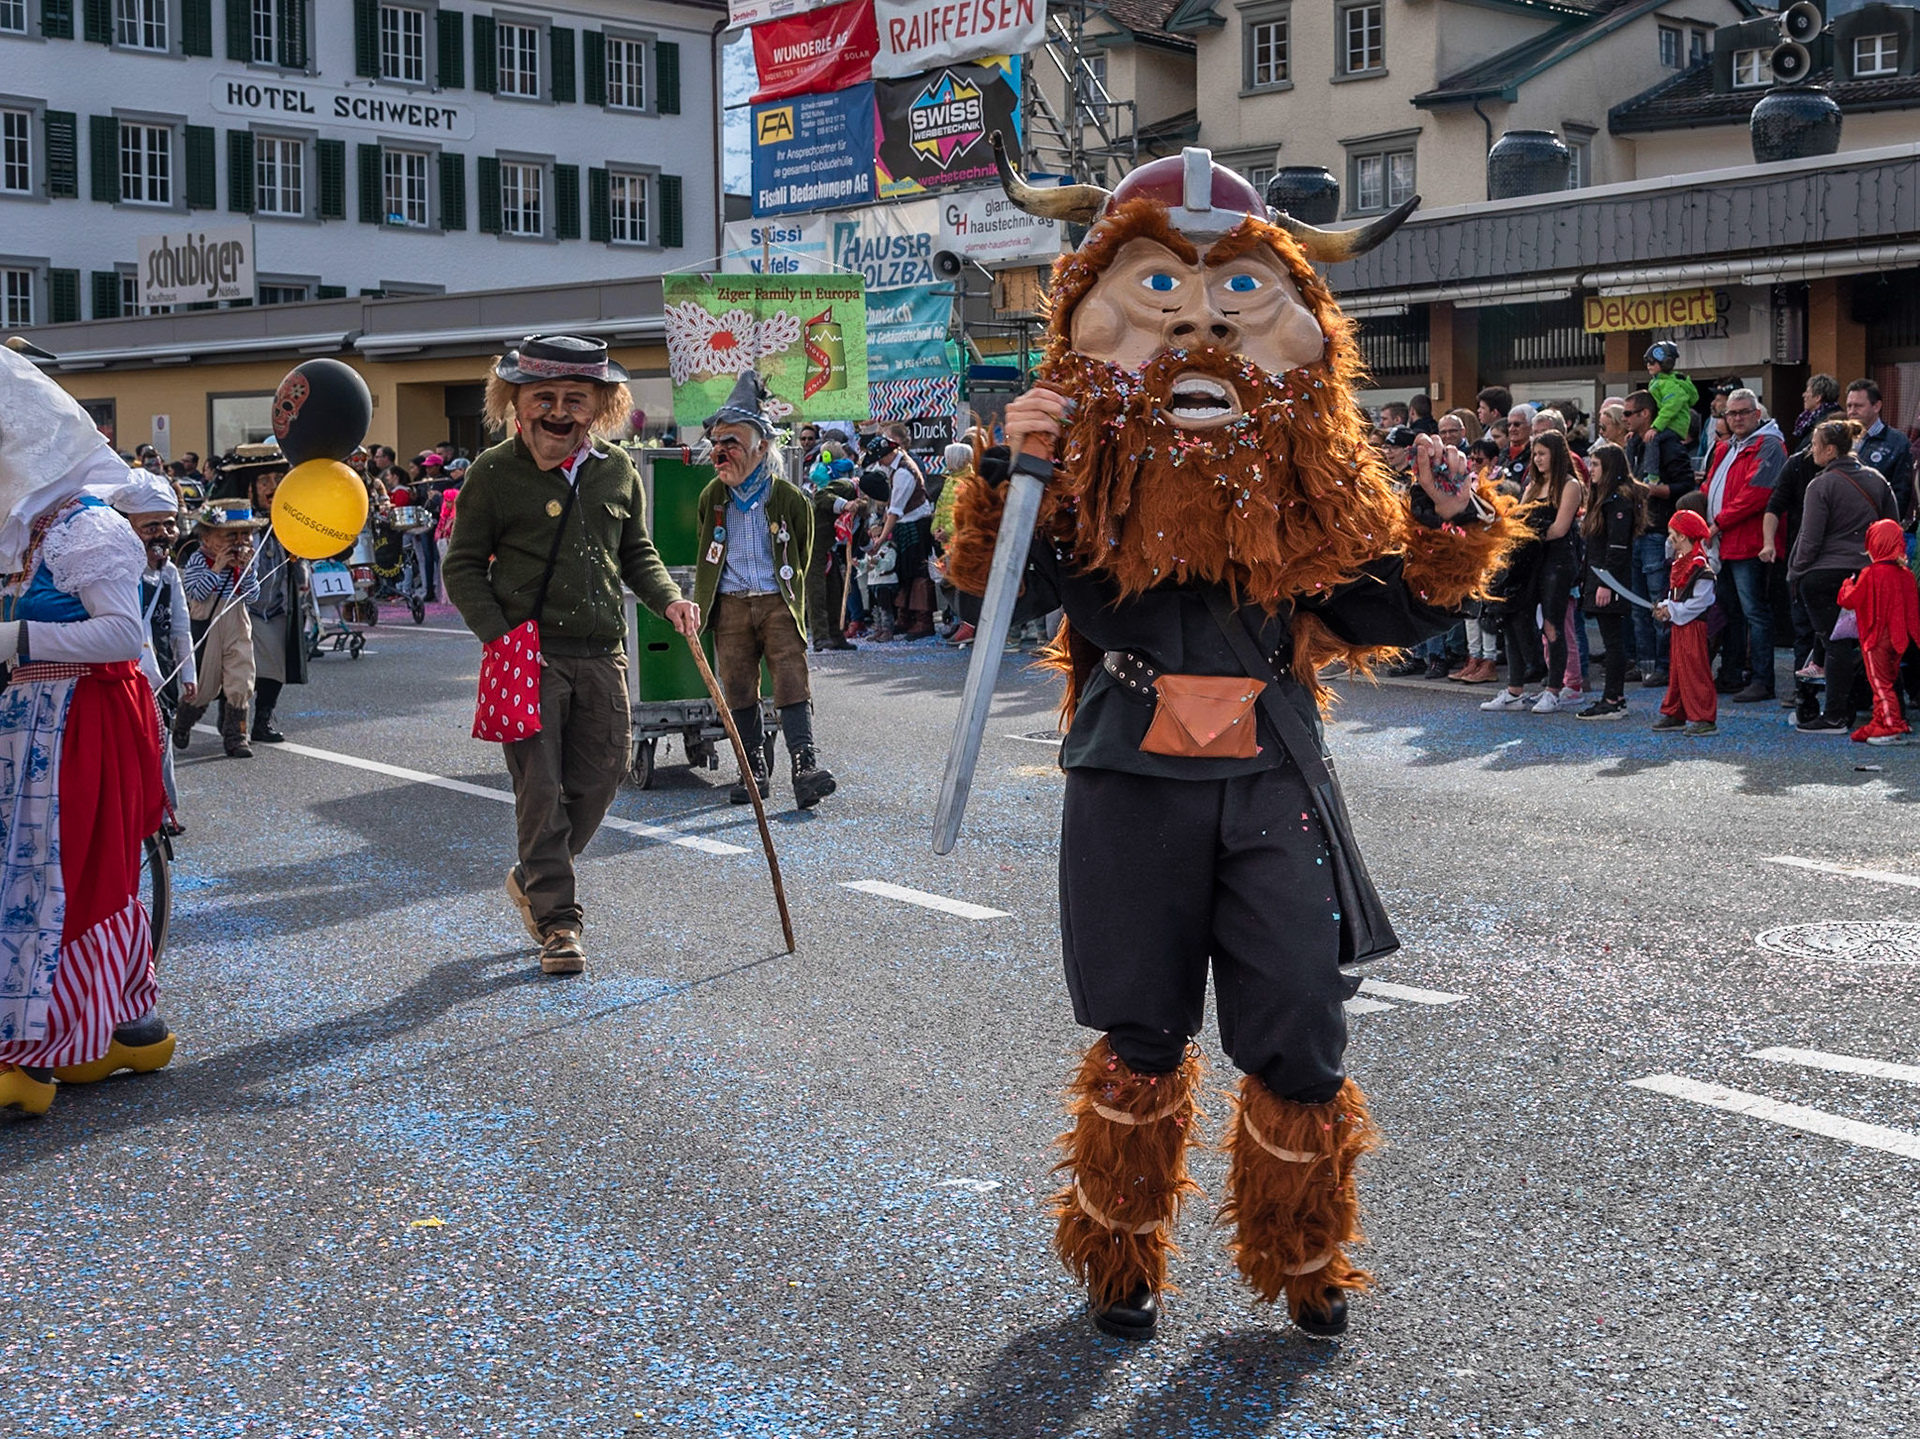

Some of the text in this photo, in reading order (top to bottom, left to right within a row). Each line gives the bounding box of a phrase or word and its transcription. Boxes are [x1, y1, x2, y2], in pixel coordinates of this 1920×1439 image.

[889, 0, 1033, 54] RAIFFEISEN
[773, 36, 831, 63] WUNDERLE
[834, 30, 848, 47] AG
[844, 50, 870, 60] SOLAR
[227, 82, 457, 130] HOTEL SCHWERT
[912, 100, 980, 131] SWISS
[760, 111, 792, 141] FA
[914, 120, 981, 141] WERBETECHNIK
[777, 150, 785, 160] Ihr
[838, 139, 846, 151] für
[782, 165, 810, 179] gesamte
[811, 155, 853, 172] Gebäudehülle
[790, 179, 852, 204] Bedachungen
[854, 173, 869, 194] AG
[970, 212, 1054, 234] haustechnik ag
[844, 233, 931, 266] HAUSER
[146, 233, 244, 298] schubiger
[146, 292, 177, 303] Kaufhaus
[718, 288, 860, 303] Ziger Family in Europa
[1587, 290, 1713, 329] Dekoriert
[1777, 316, 1788, 358] BISTRO
[913, 421, 947, 440] Druck
[322, 578, 347, 593] 11
